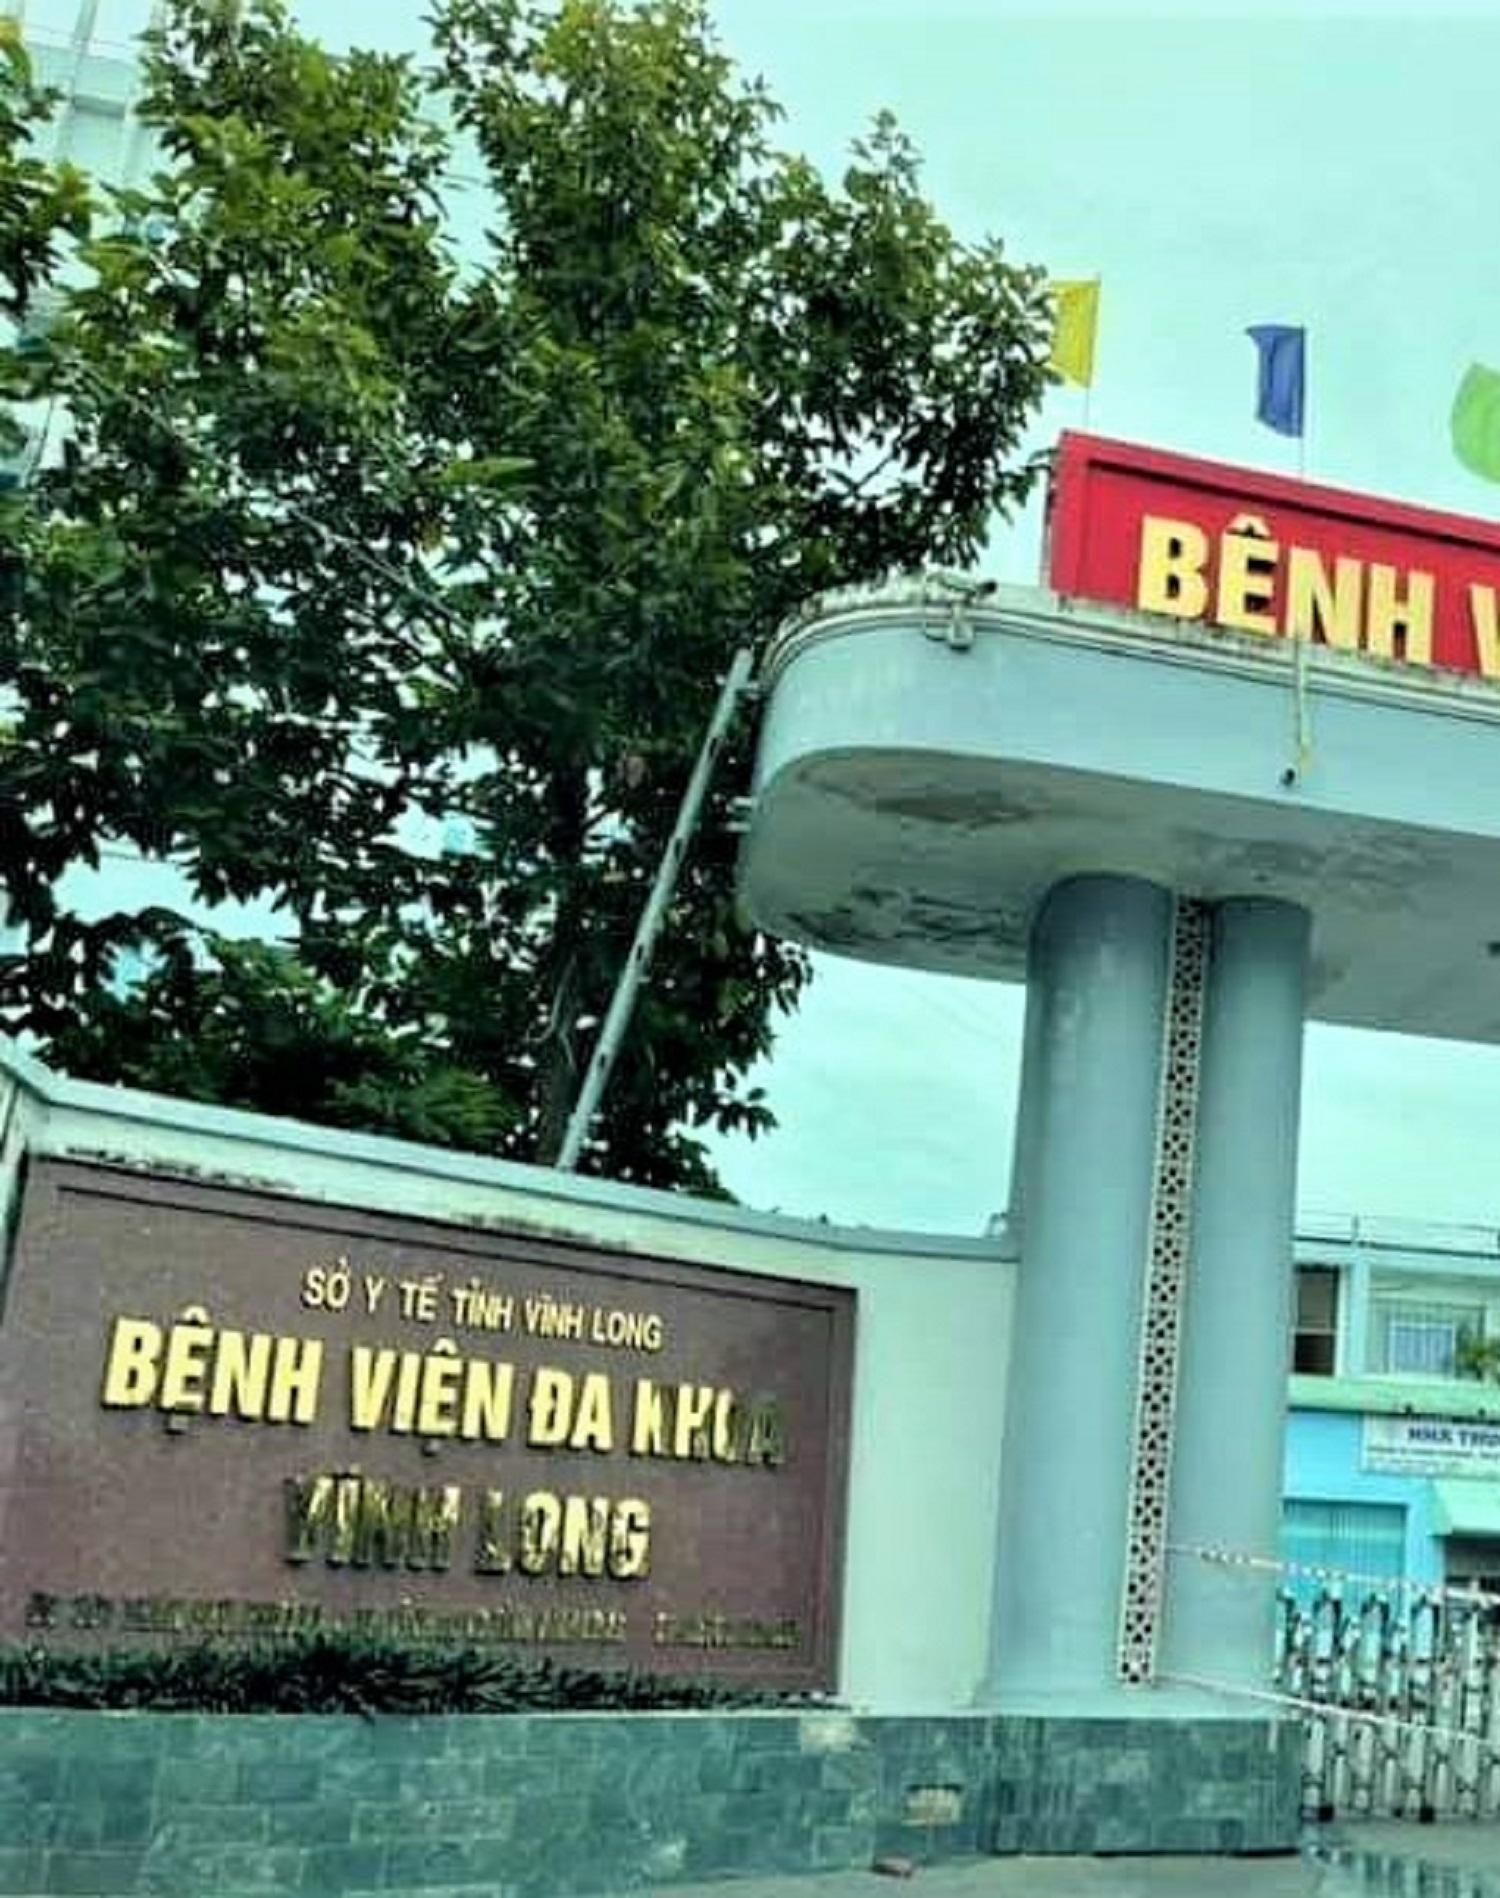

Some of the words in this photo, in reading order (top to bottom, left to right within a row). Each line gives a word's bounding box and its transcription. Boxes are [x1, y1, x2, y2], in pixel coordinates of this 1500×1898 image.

[303, 1257, 349, 1308] SỞ
[364, 1275, 384, 1314] Y
[400, 1272, 438, 1320] TẾ
[452, 1277, 513, 1330] TỈNH
[525, 1295, 583, 1338] VĨNH
[592, 1306, 662, 1350] LONG
[104, 1306, 323, 1432] BỆNH
[350, 1339, 514, 1454] VIỆN
[529, 1367, 613, 1451] ĐA
[475, 1487, 651, 1579] LONG
